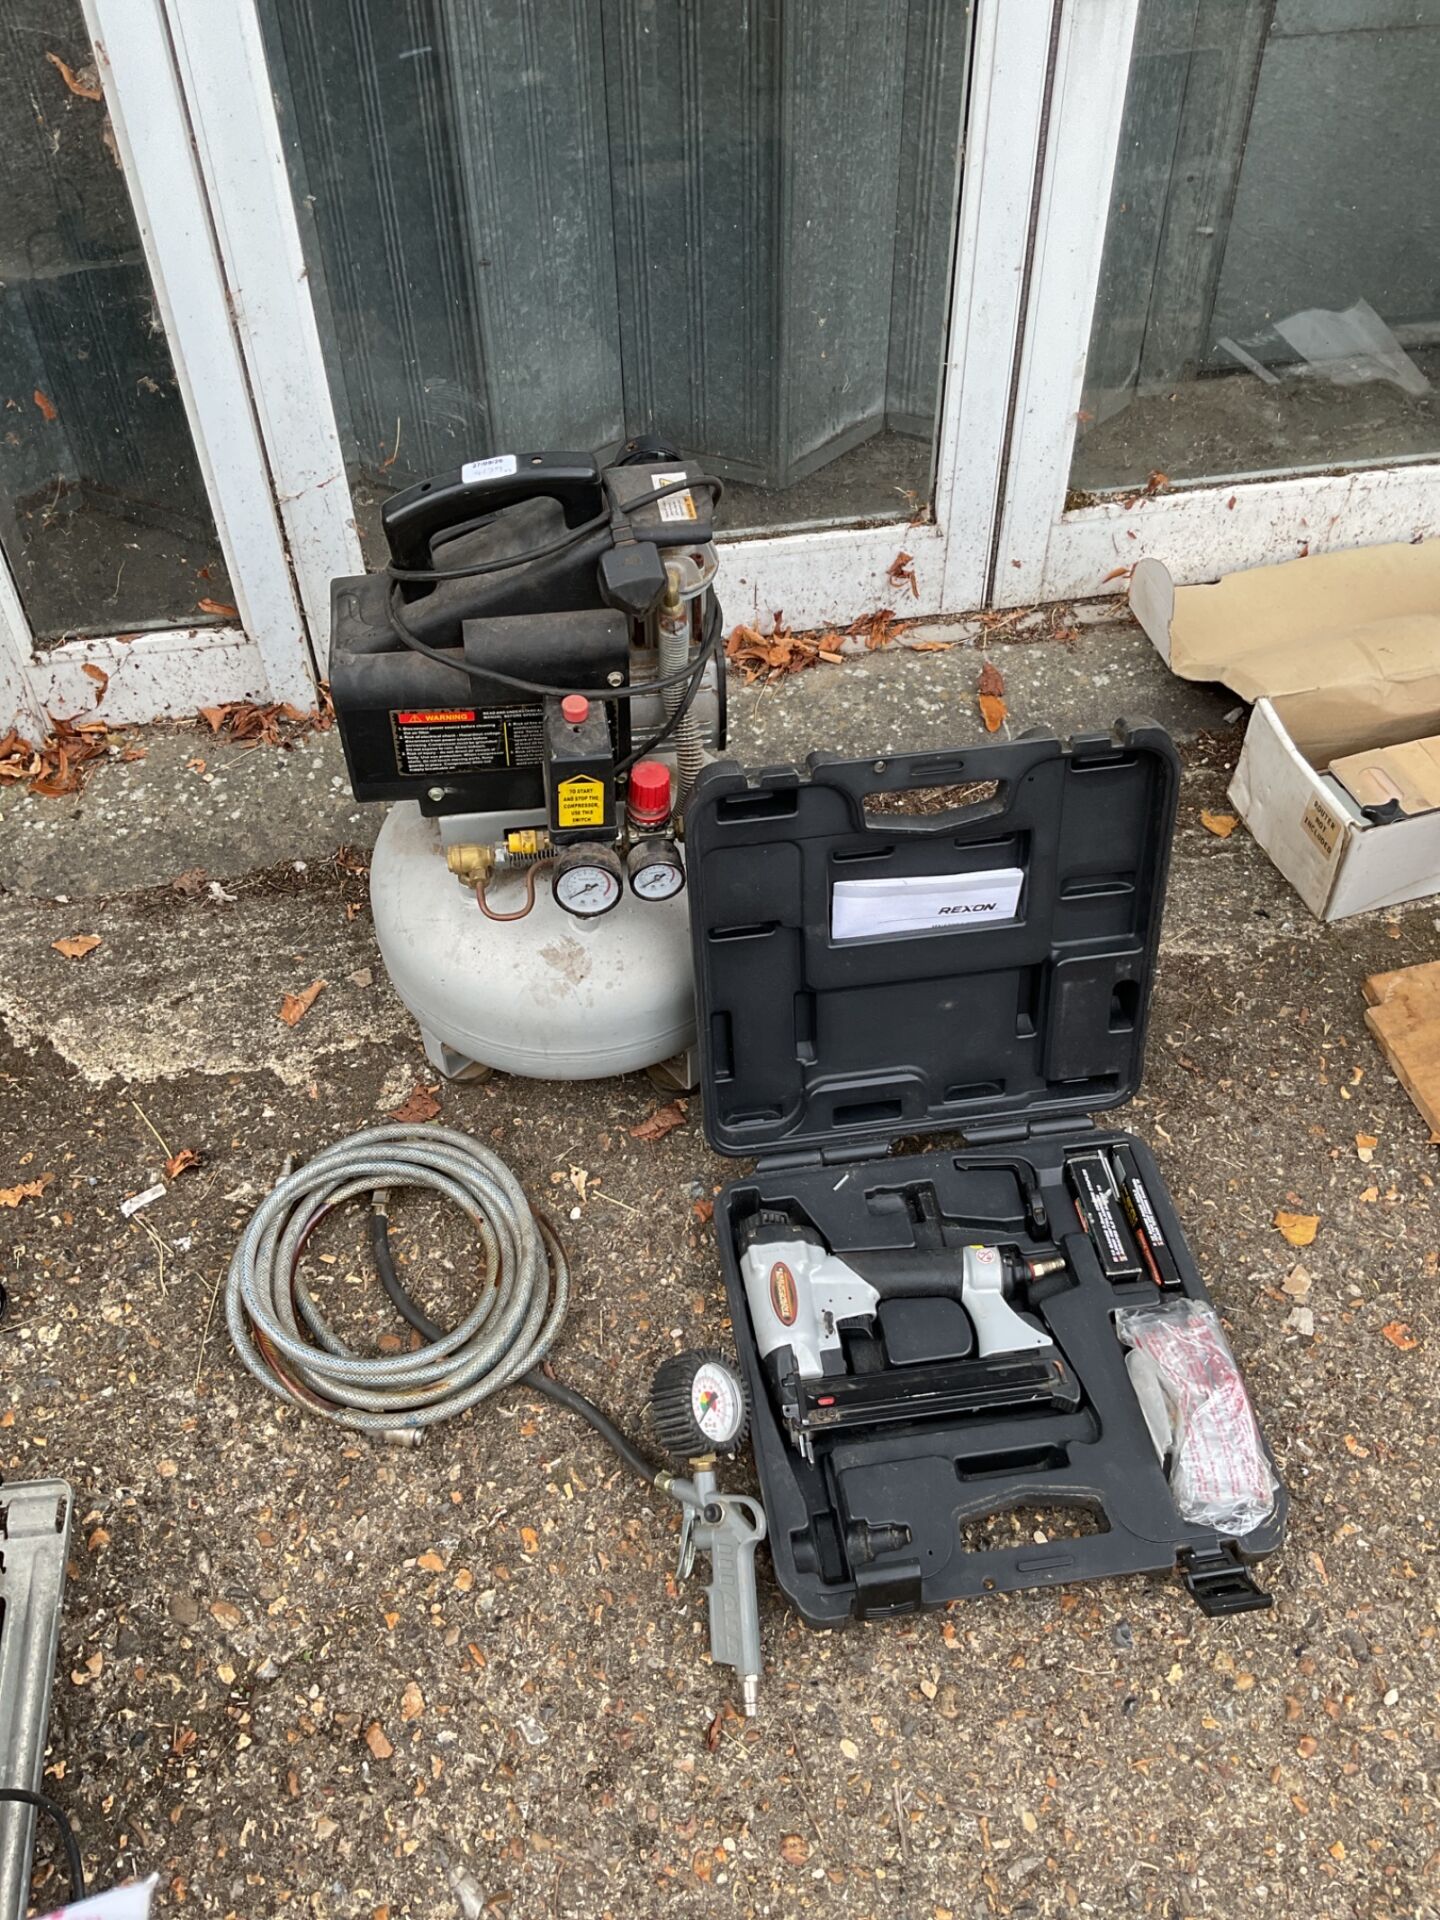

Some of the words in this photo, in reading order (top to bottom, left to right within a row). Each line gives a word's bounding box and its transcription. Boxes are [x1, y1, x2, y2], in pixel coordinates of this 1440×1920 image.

[425, 713, 468, 721] WARNING
[1314, 800, 1336, 830] ROUTER
[1315, 816, 1328, 832] NOT
[1303, 816, 1332, 854] INCLUDED
[938, 902, 998, 914] REXON
